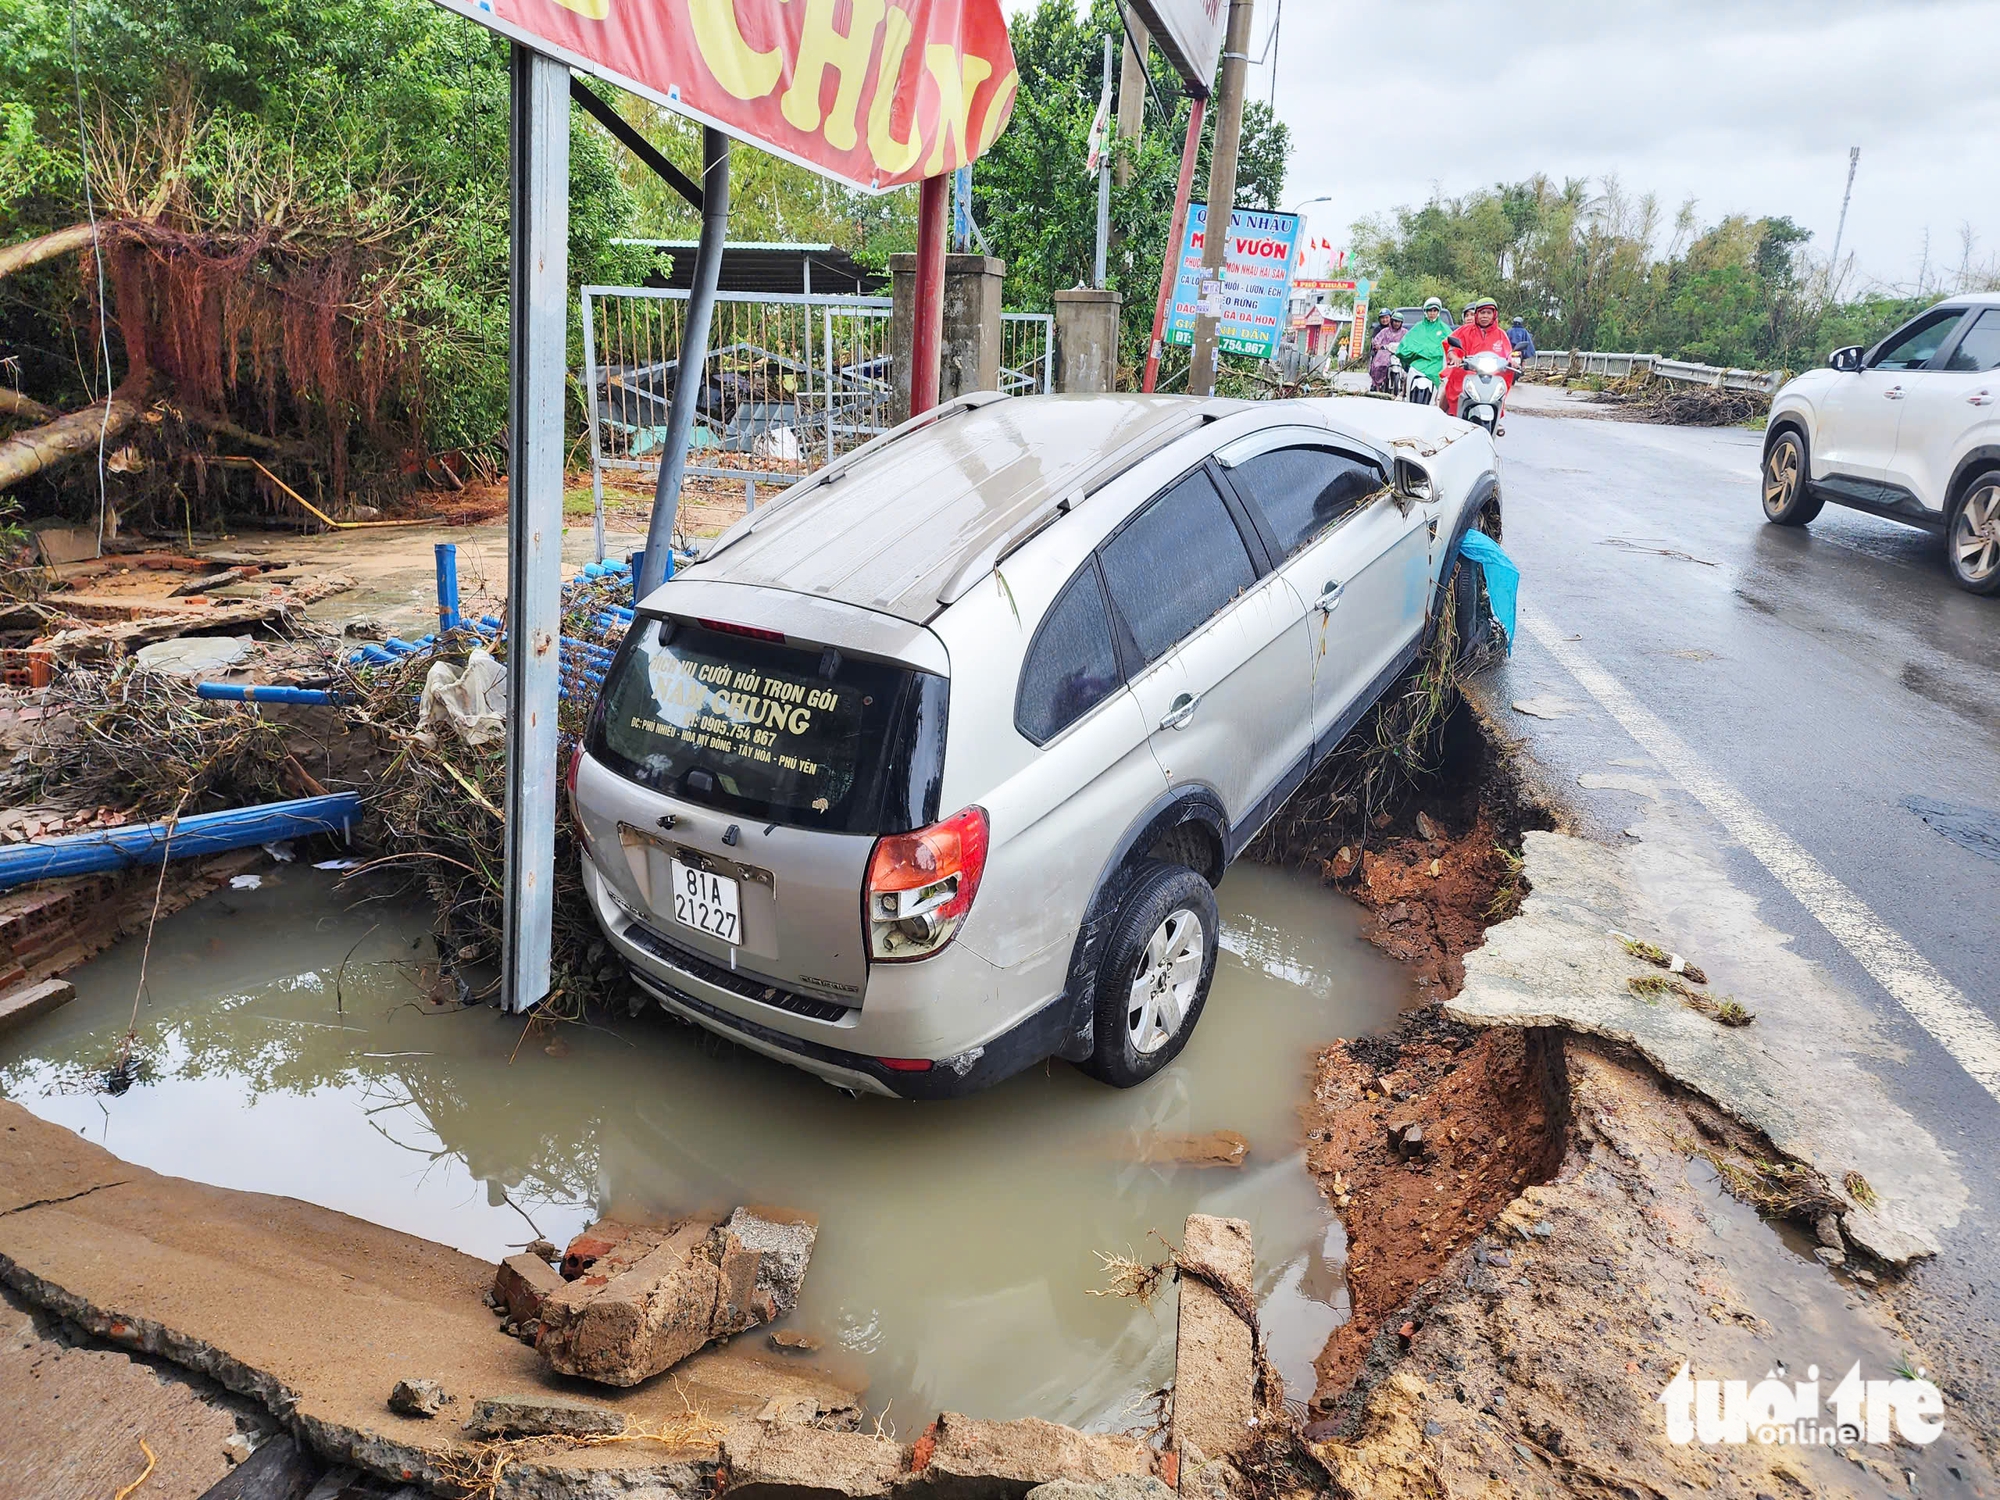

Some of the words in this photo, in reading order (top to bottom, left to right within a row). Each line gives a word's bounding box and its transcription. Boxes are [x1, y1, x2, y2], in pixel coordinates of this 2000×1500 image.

[1197, 210, 1241, 226] QN
[1246, 214, 1292, 234] NHẬU
[1236, 238, 1288, 259] VƯỜN
[1219, 338, 1266, 355] .754.867
[698, 663, 733, 687] CƯỚI
[732, 668, 761, 693] HỎI
[762, 678, 806, 704] TRỌN
[806, 688, 838, 712] GÓI
[651, 676, 709, 711] NAM
[711, 689, 811, 735] CHUNG
[738, 743, 754, 758] TÂY
[754, 747, 772, 764] HÒA
[778, 755, 797, 770] PHÚ
[799, 758, 817, 775] YÊN
[686, 869, 722, 907] 81A
[675, 893, 737, 939] 212.27
